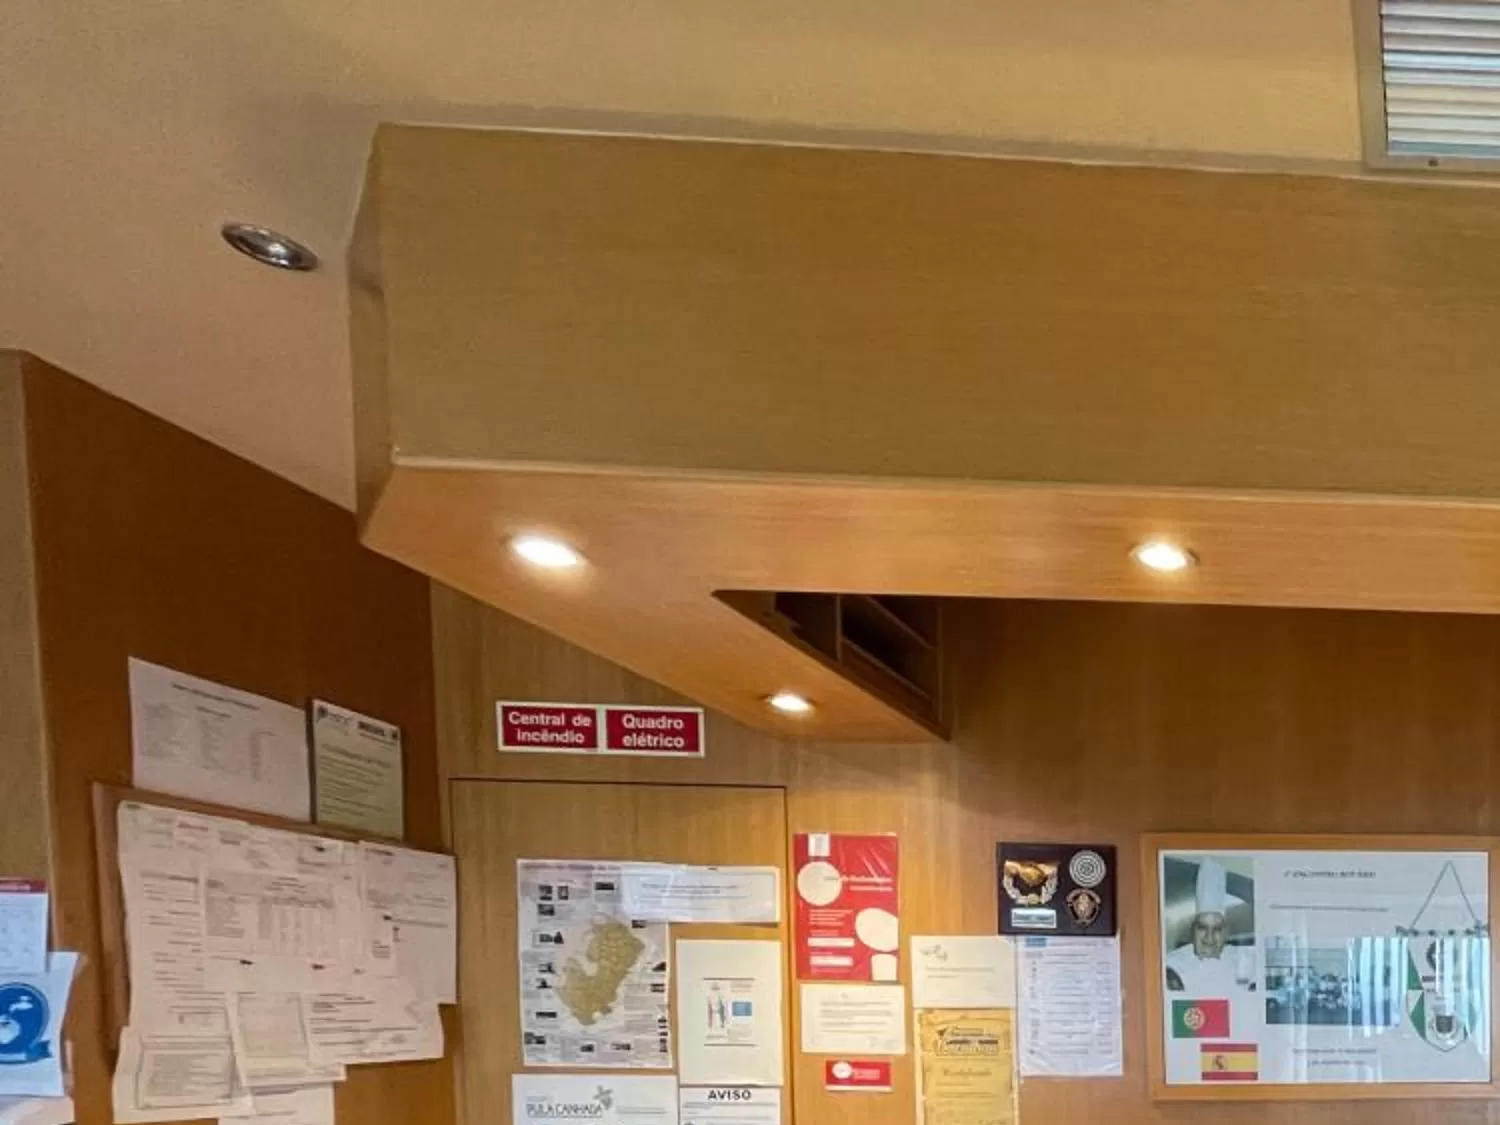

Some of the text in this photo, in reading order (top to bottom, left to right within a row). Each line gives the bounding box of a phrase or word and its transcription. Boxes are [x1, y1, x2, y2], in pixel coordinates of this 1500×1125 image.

[508, 711, 592, 728] Central de
[621, 713, 684, 730] Quadro
[621, 732, 685, 748] elétrico
[707, 1088, 752, 1101] AVISO
